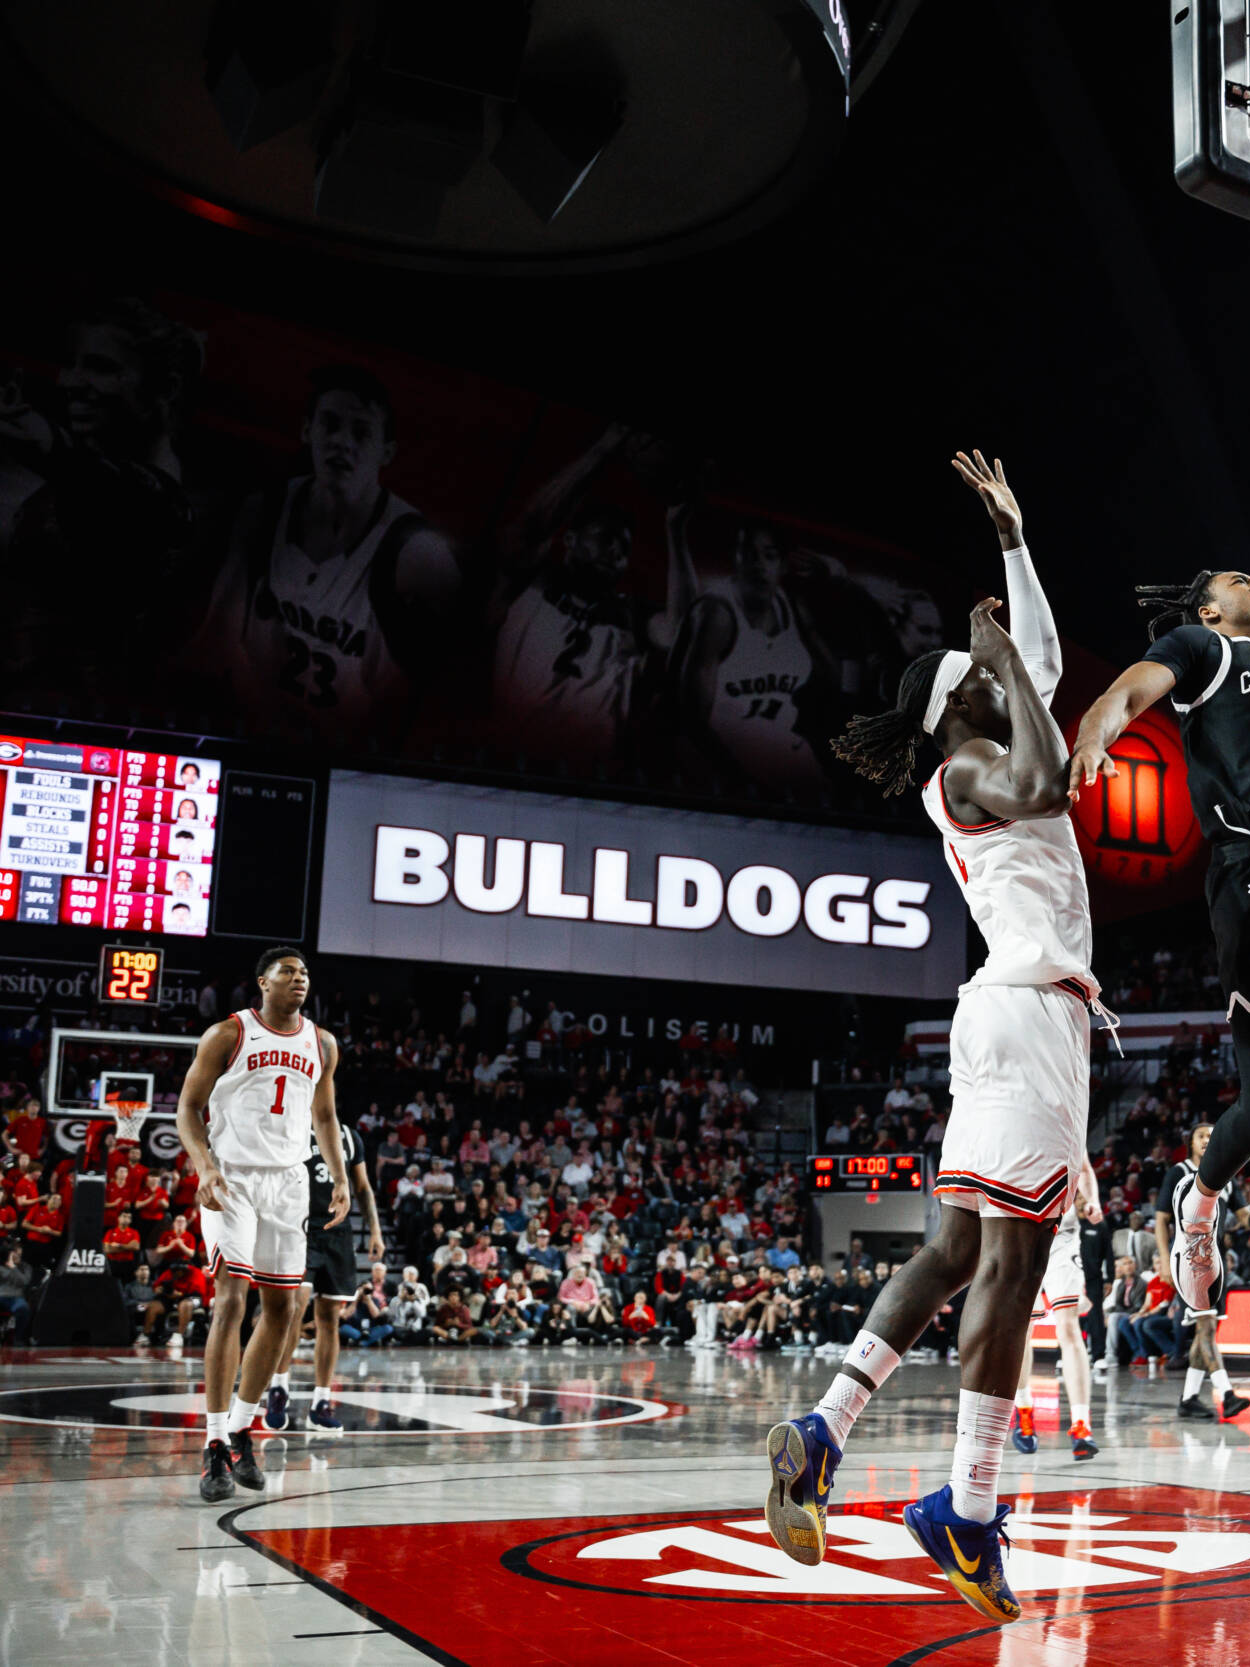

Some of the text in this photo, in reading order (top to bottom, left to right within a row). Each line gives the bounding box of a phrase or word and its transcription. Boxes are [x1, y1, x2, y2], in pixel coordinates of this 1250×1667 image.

[33, 772, 72, 789] FOULS
[20, 789, 81, 805] REBOUNDS
[26, 804, 72, 821] BLOCKS
[26, 822, 70, 835] STEALS
[21, 836, 71, 853] ASSISTS
[10, 852, 79, 869] TURNOVERS
[372, 824, 931, 950] BULLDOGS
[112, 951, 158, 972] 17:00
[55, 970, 91, 998] of
[108, 968, 151, 1000] 22
[560, 1010, 775, 1047] COLISEUM
[247, 1050, 315, 1080] GEORGIA
[270, 1075, 287, 1115] 1
[847, 1156, 889, 1175] 17:00
[67, 1248, 106, 1267] Alfa
